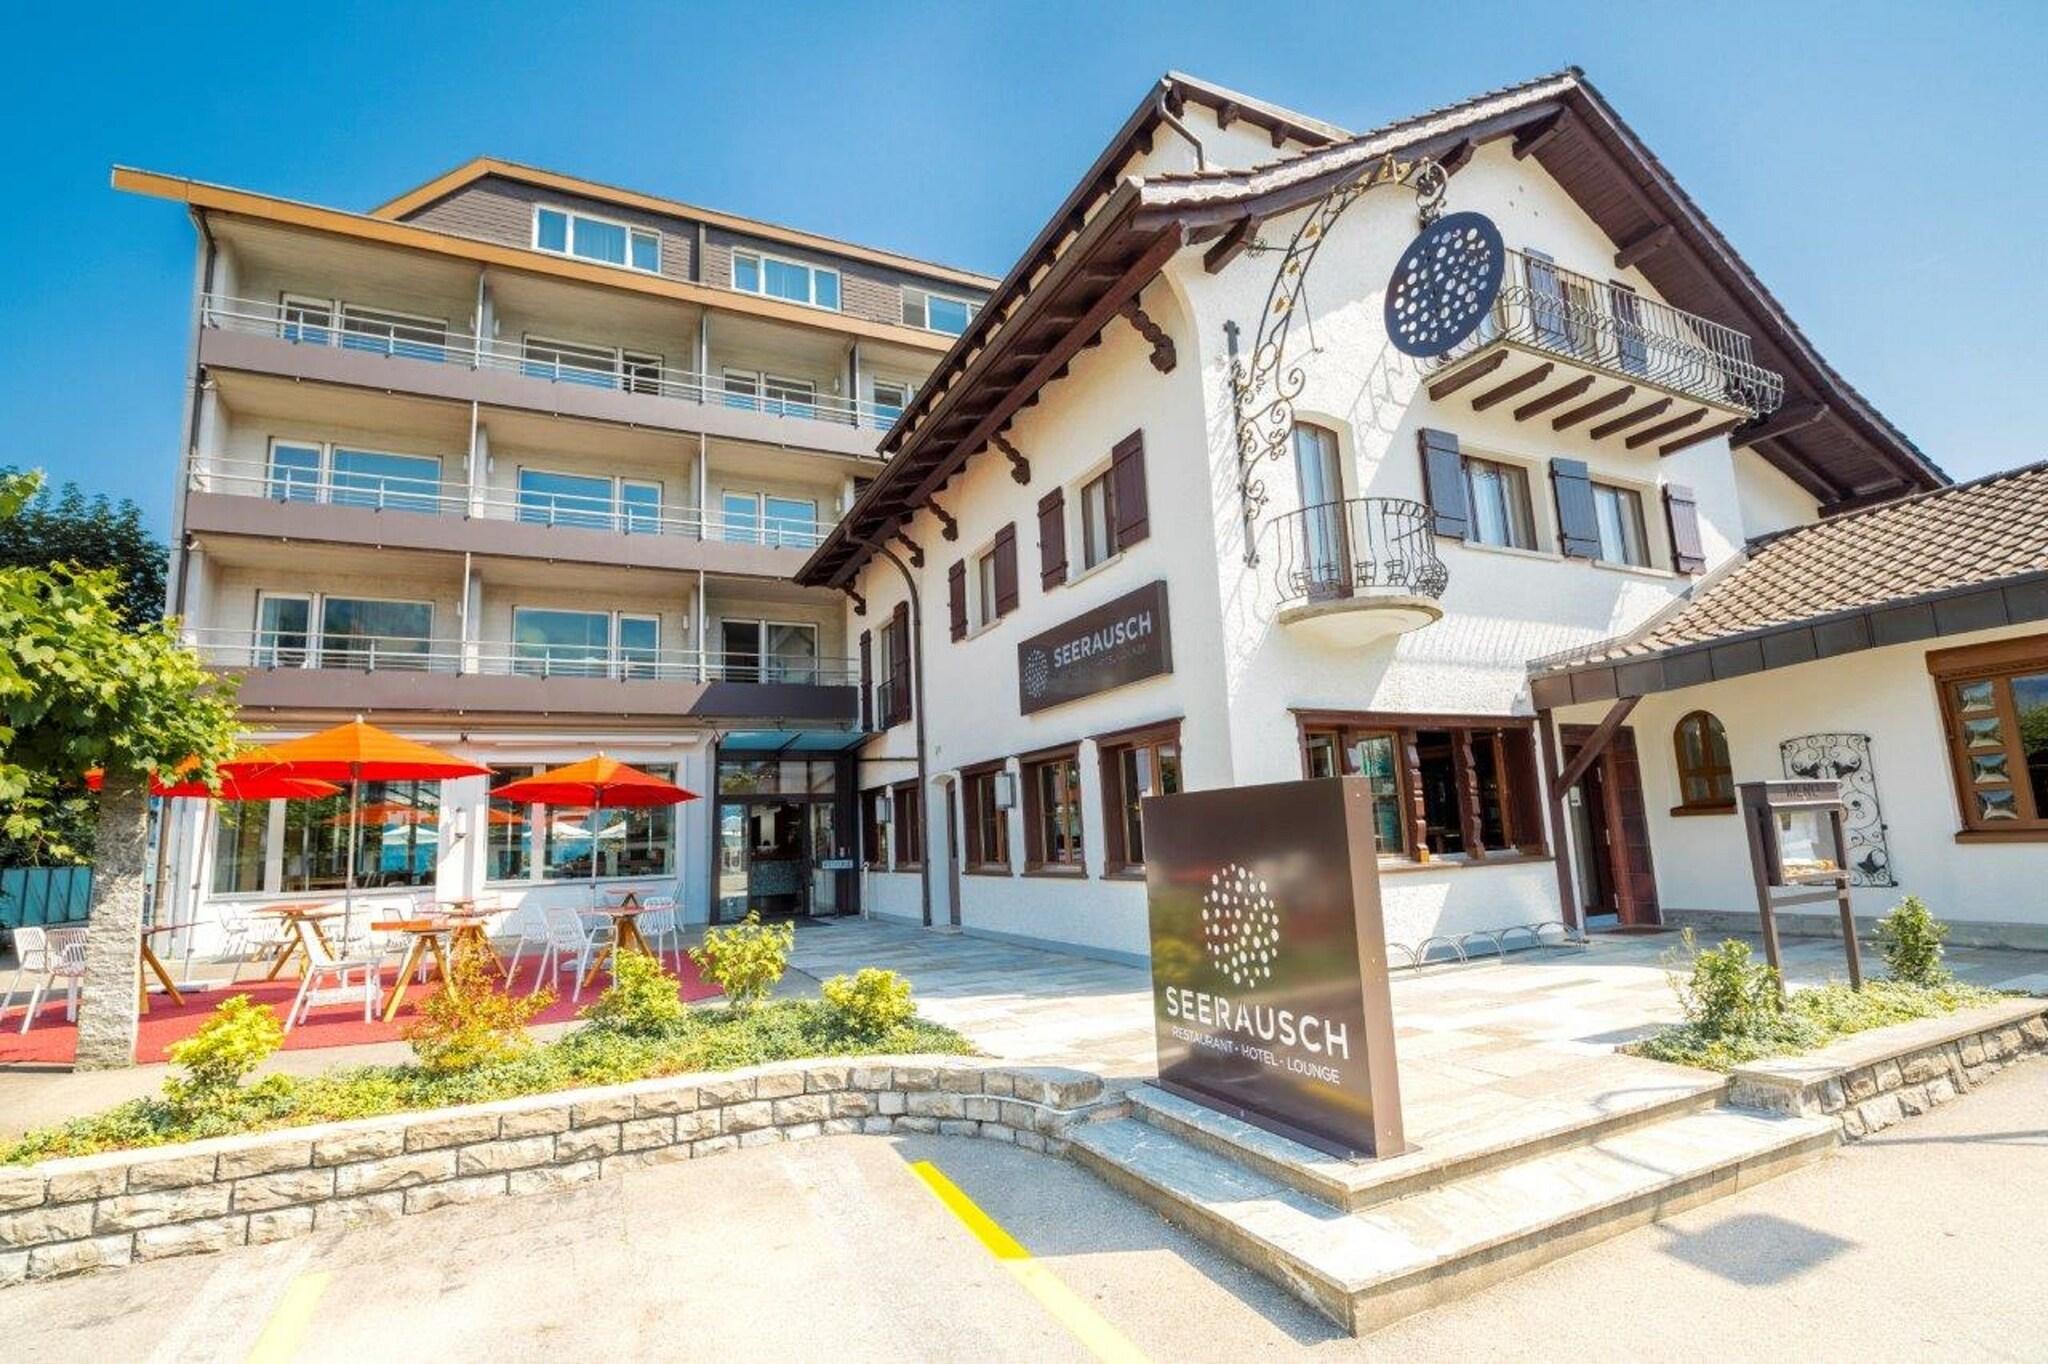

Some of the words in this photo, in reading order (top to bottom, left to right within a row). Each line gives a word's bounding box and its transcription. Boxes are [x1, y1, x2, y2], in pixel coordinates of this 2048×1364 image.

[1053, 610, 1152, 668] SEERAUSCH
[1166, 986, 1349, 1059] SEERAUSCH
[1171, 1026, 1234, 1053] RESTAURANT
[1242, 1045, 1279, 1067] HOTEL
[1287, 1058, 1341, 1085] LOUNGE
